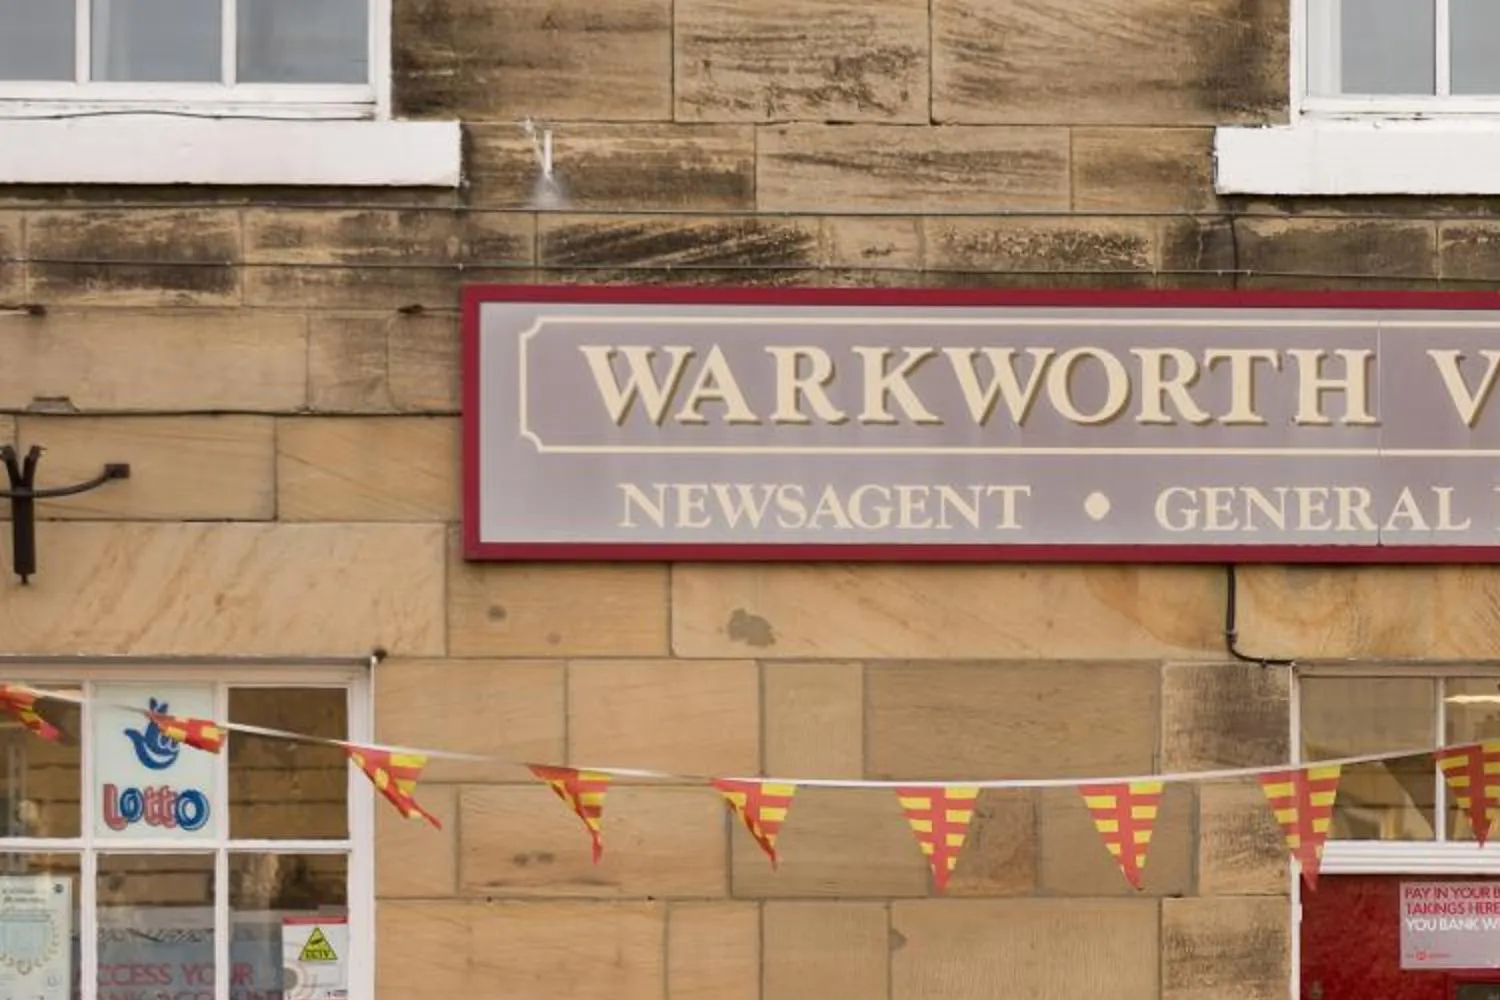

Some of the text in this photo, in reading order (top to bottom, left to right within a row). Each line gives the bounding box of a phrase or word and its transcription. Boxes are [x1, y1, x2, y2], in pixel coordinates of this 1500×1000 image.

[580, 345, 1381, 428] WARKWORTH
[618, 483, 1031, 531] NEWSAGENT
[1154, 484, 1470, 533] GENERAL
[1405, 886, 1432, 899] PAY
[1434, 886, 1449, 899] IN
[1450, 886, 1491, 899] YOUR
[1407, 901, 1466, 915] TAKINGS
[1406, 917, 1437, 931] YOU
[1439, 917, 1478, 931] BANK
